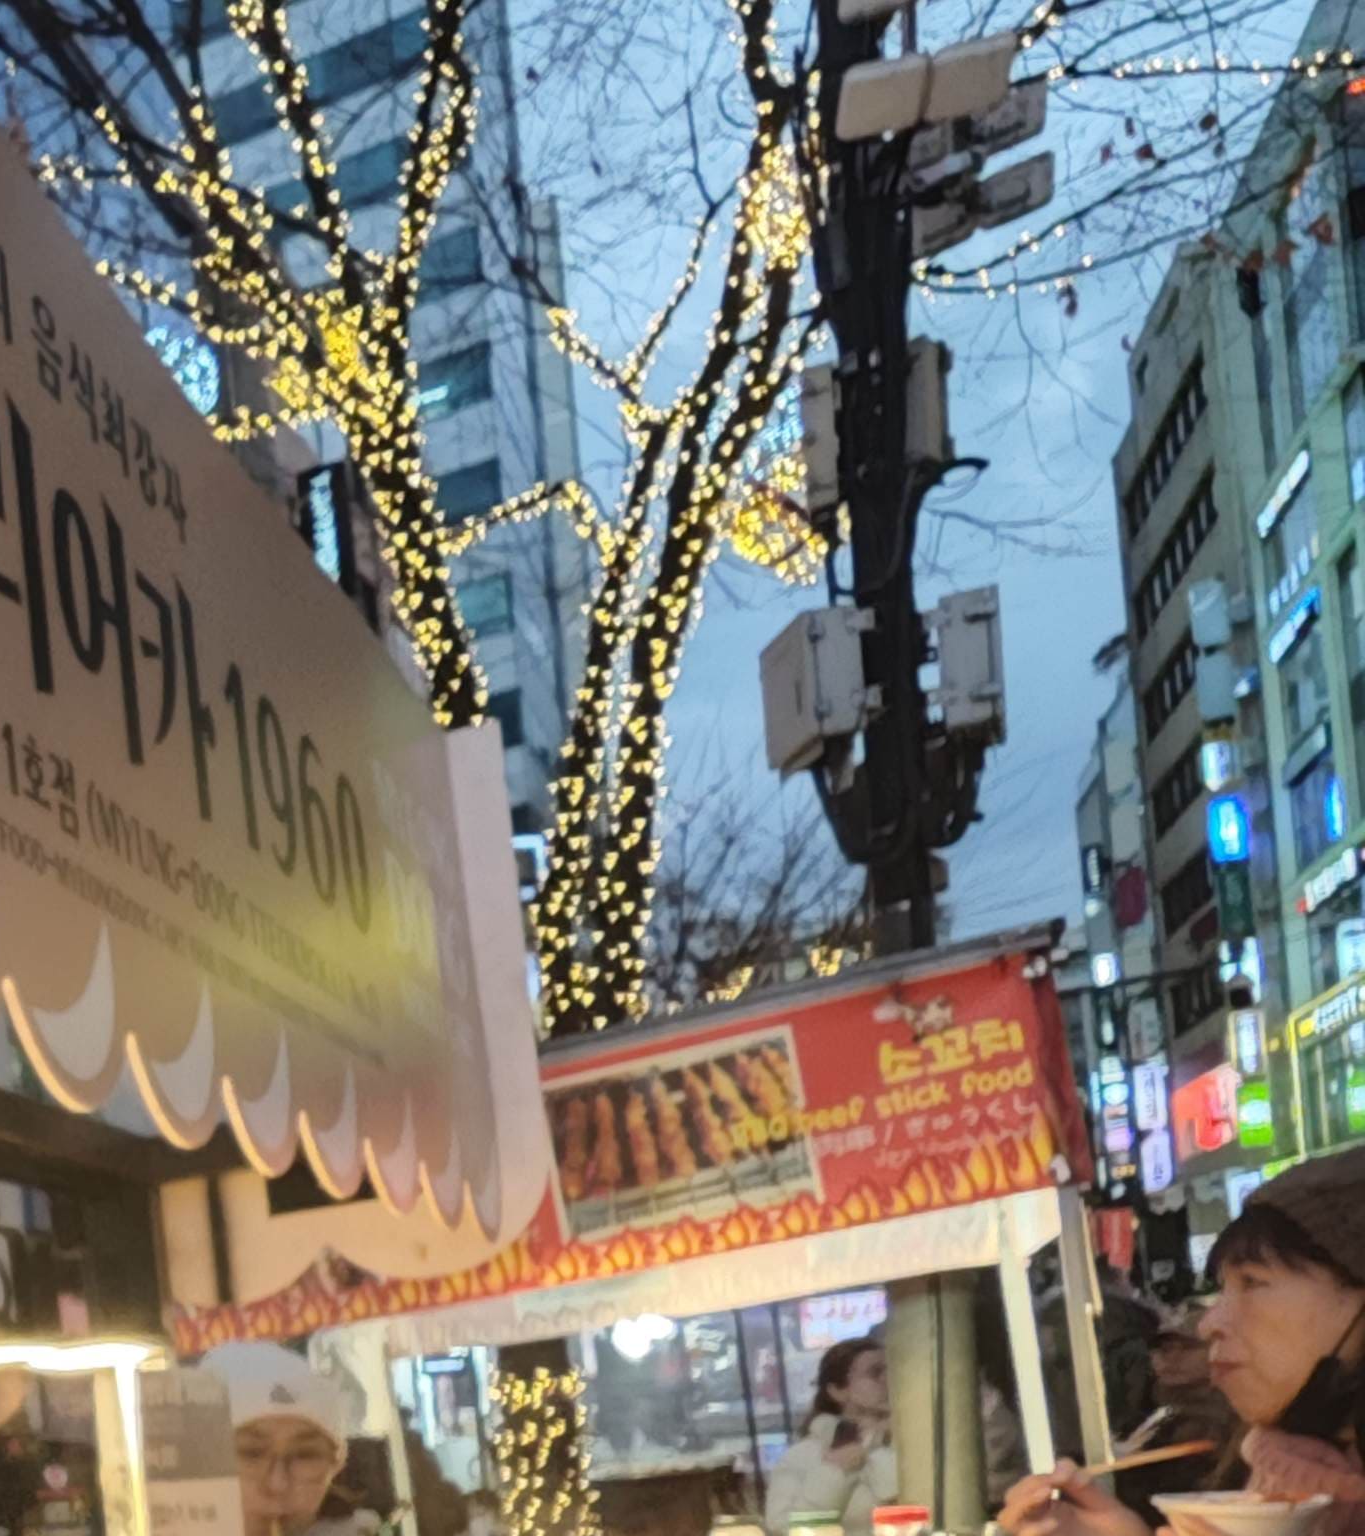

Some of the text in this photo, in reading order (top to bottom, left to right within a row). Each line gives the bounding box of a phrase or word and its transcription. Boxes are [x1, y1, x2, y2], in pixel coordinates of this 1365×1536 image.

[0, 722, 81, 841] 1호점
[223, 662, 373, 936] 1960
[873, 1082, 952, 1120] stick
[960, 1058, 1034, 1099] food
